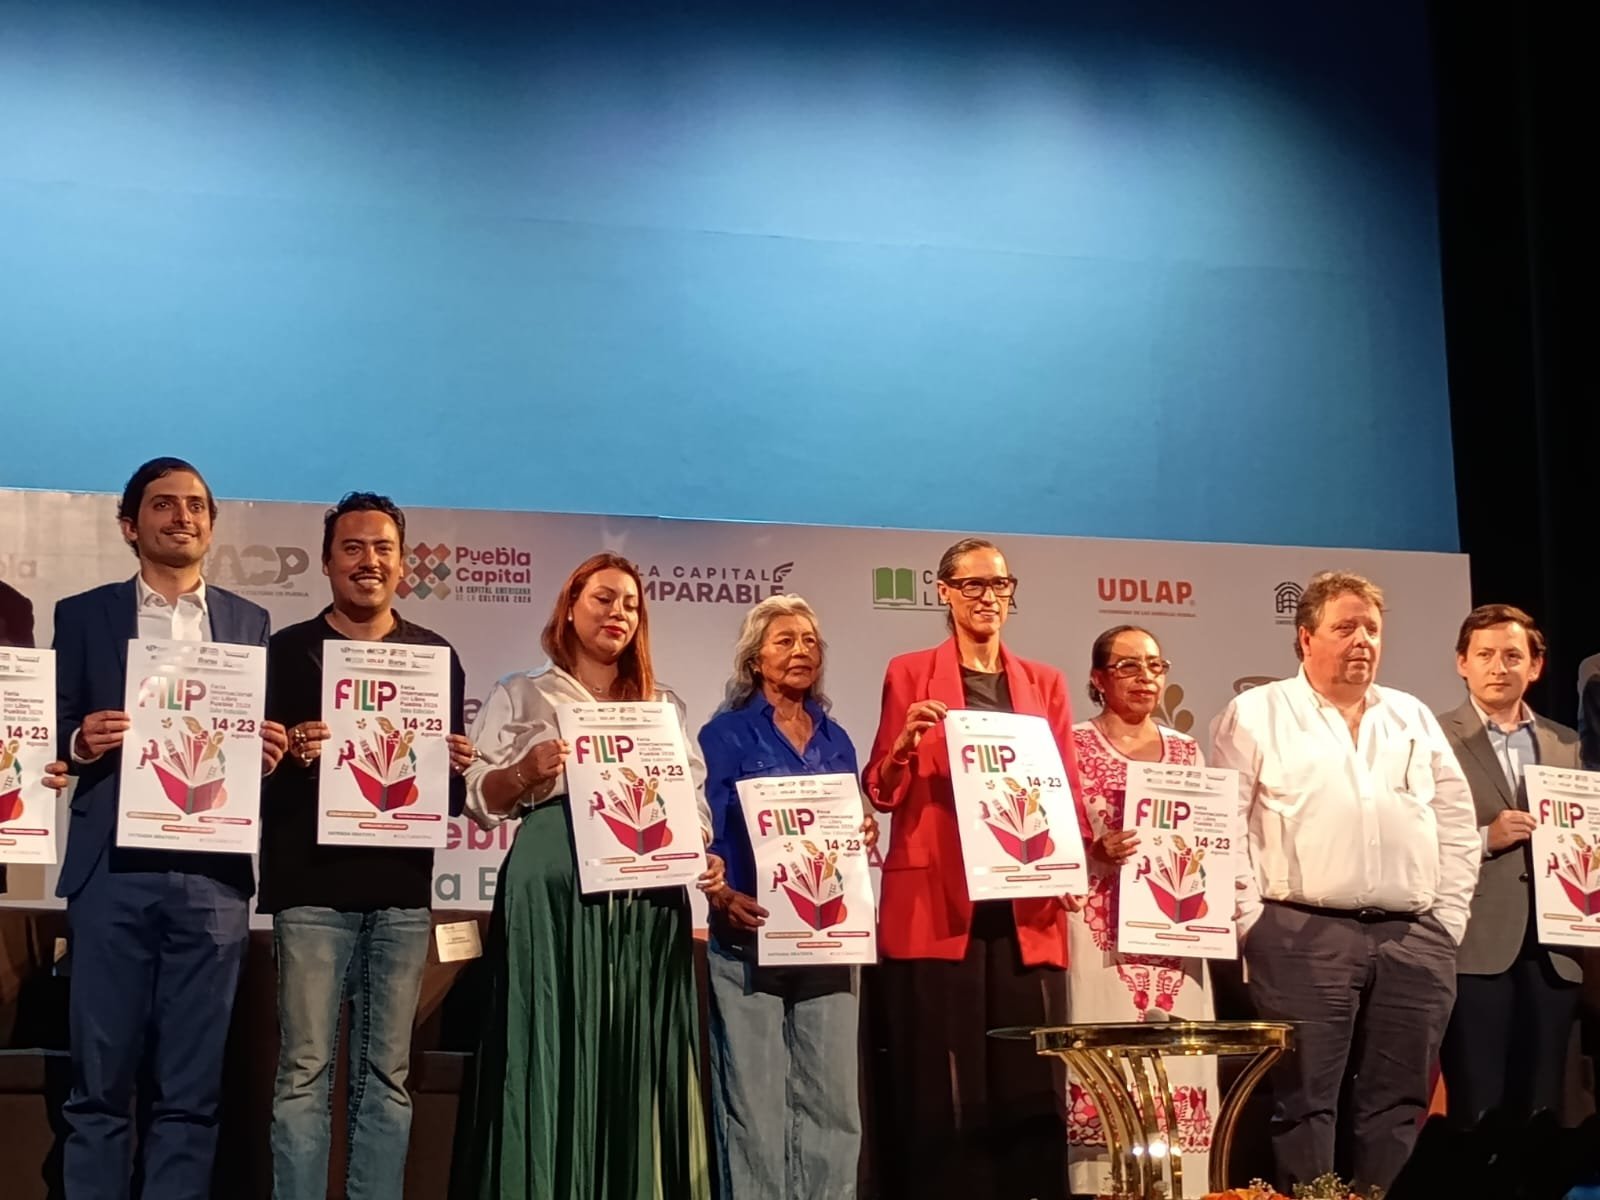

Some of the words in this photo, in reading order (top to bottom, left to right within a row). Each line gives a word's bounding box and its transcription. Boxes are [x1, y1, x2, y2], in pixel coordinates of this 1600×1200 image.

[455, 546, 531, 566] Puebla
[455, 567, 531, 586] Capital
[673, 566, 770, 582] CAPITAL
[466, 586, 492, 594] CAPITAL
[1097, 577, 1193, 605] UDLAP
[335, 679, 397, 712] FILIP
[575, 735, 634, 764] FILIP
[961, 744, 1016, 773] FILIP
[757, 808, 815, 836] FILIP
[1135, 798, 1191, 830] FILIP
[1539, 799, 1585, 829] FILIP
